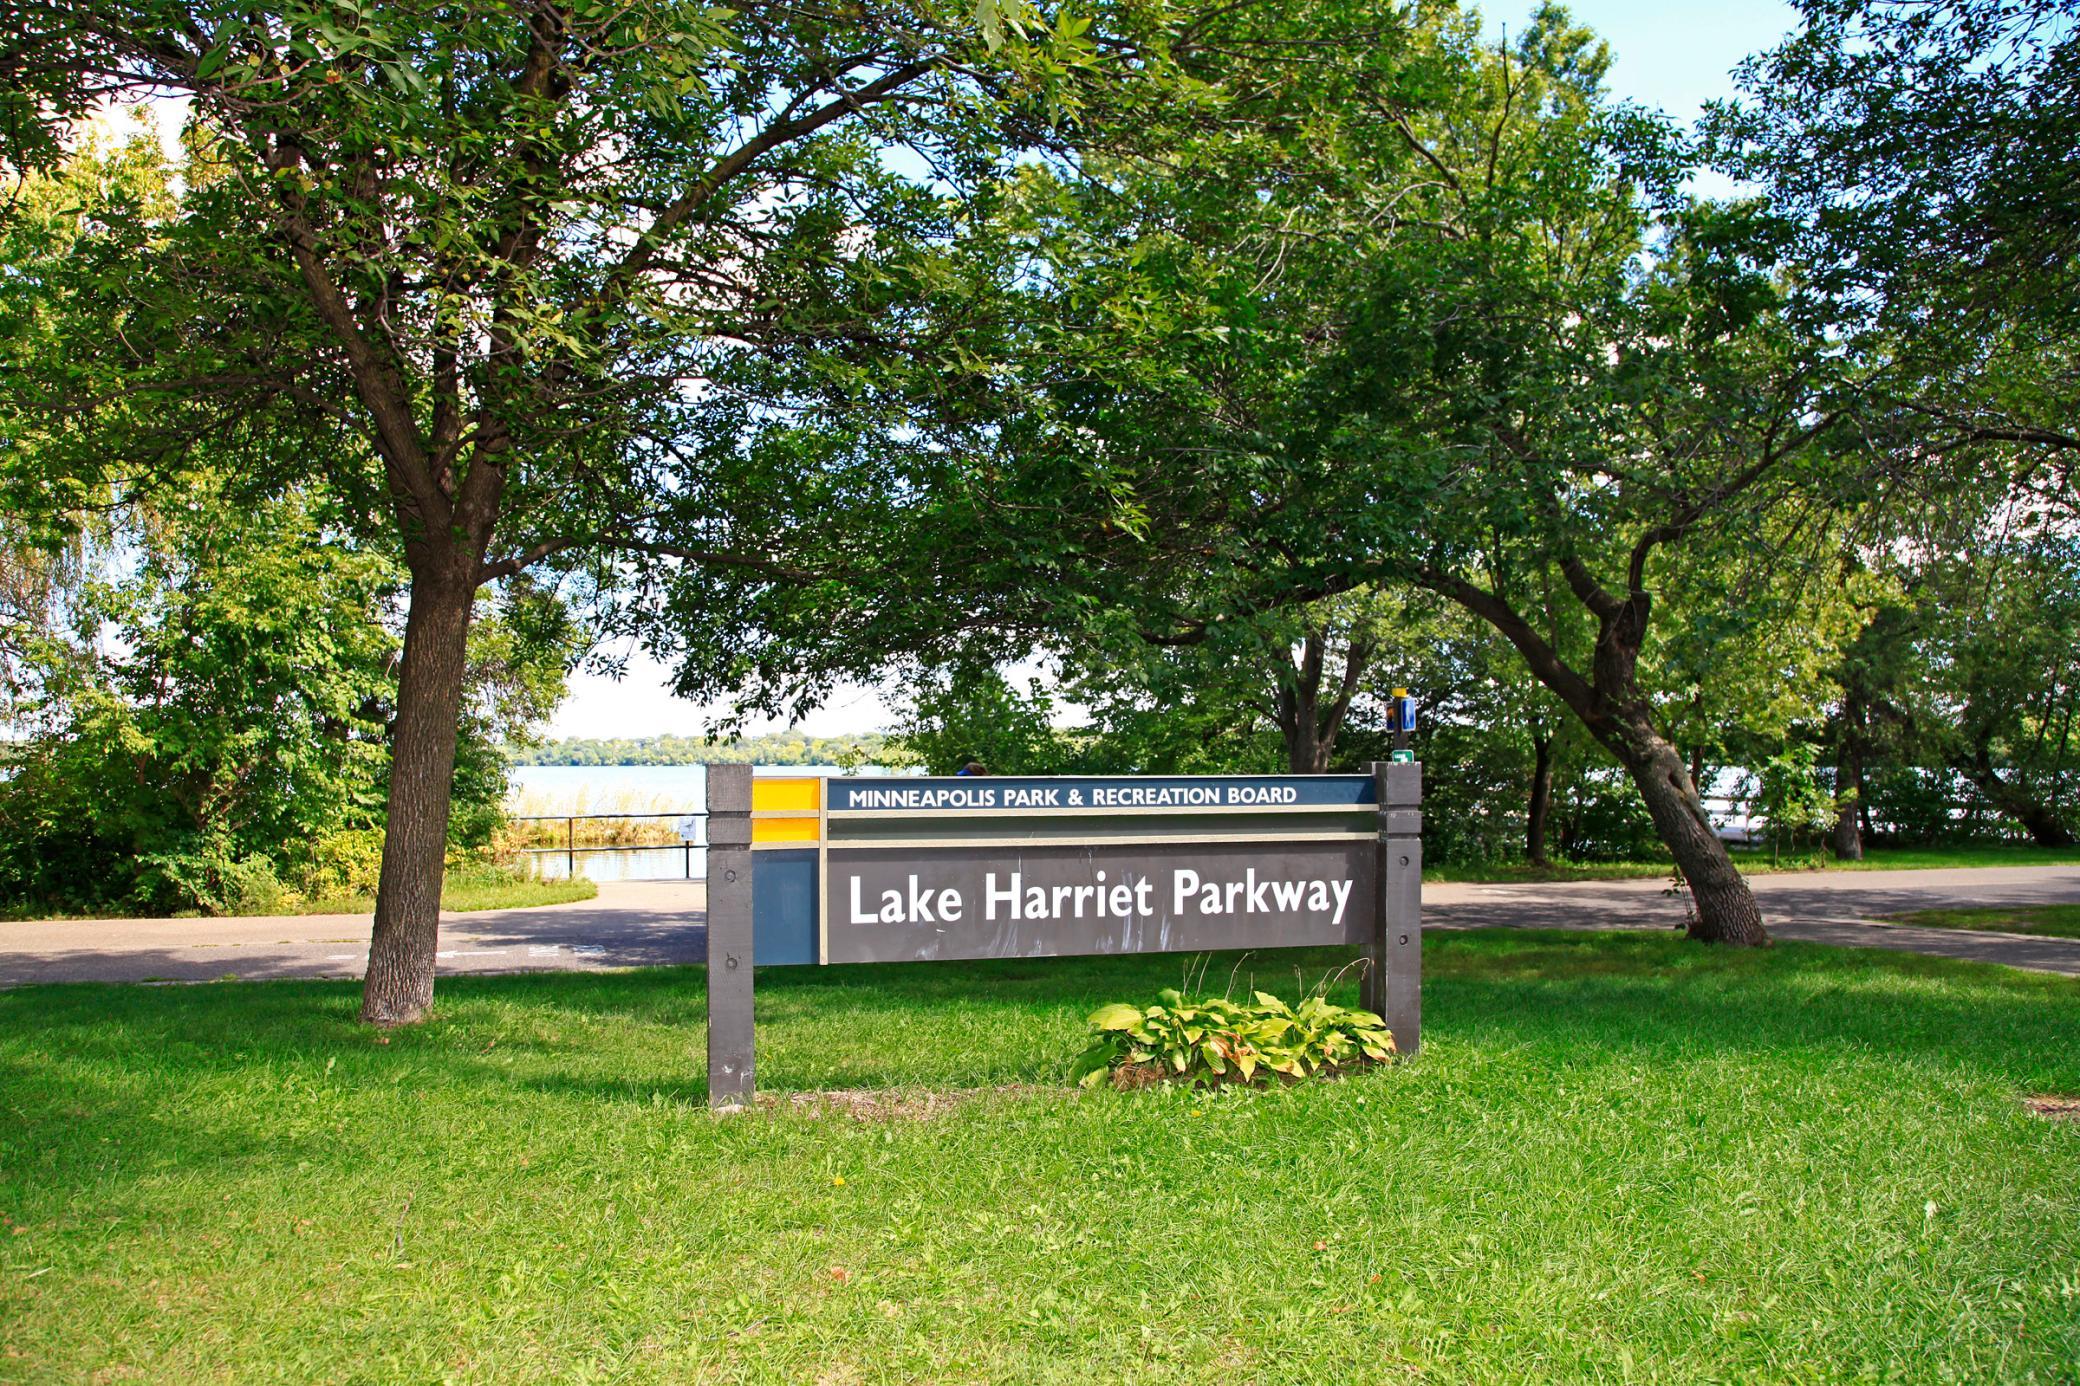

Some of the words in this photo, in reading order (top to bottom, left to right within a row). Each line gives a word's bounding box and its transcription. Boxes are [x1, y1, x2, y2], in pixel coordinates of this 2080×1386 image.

[849, 790, 996, 809] MINNEAPOLIS
[1004, 789, 1060, 807] PARK
[1068, 788, 1084, 806] &
[1093, 787, 1220, 806] RECREATION
[1228, 786, 1297, 804] BOARD
[850, 874, 963, 925] Lake
[985, 870, 1154, 921] Harriet
[1173, 867, 1354, 926] Parkway
